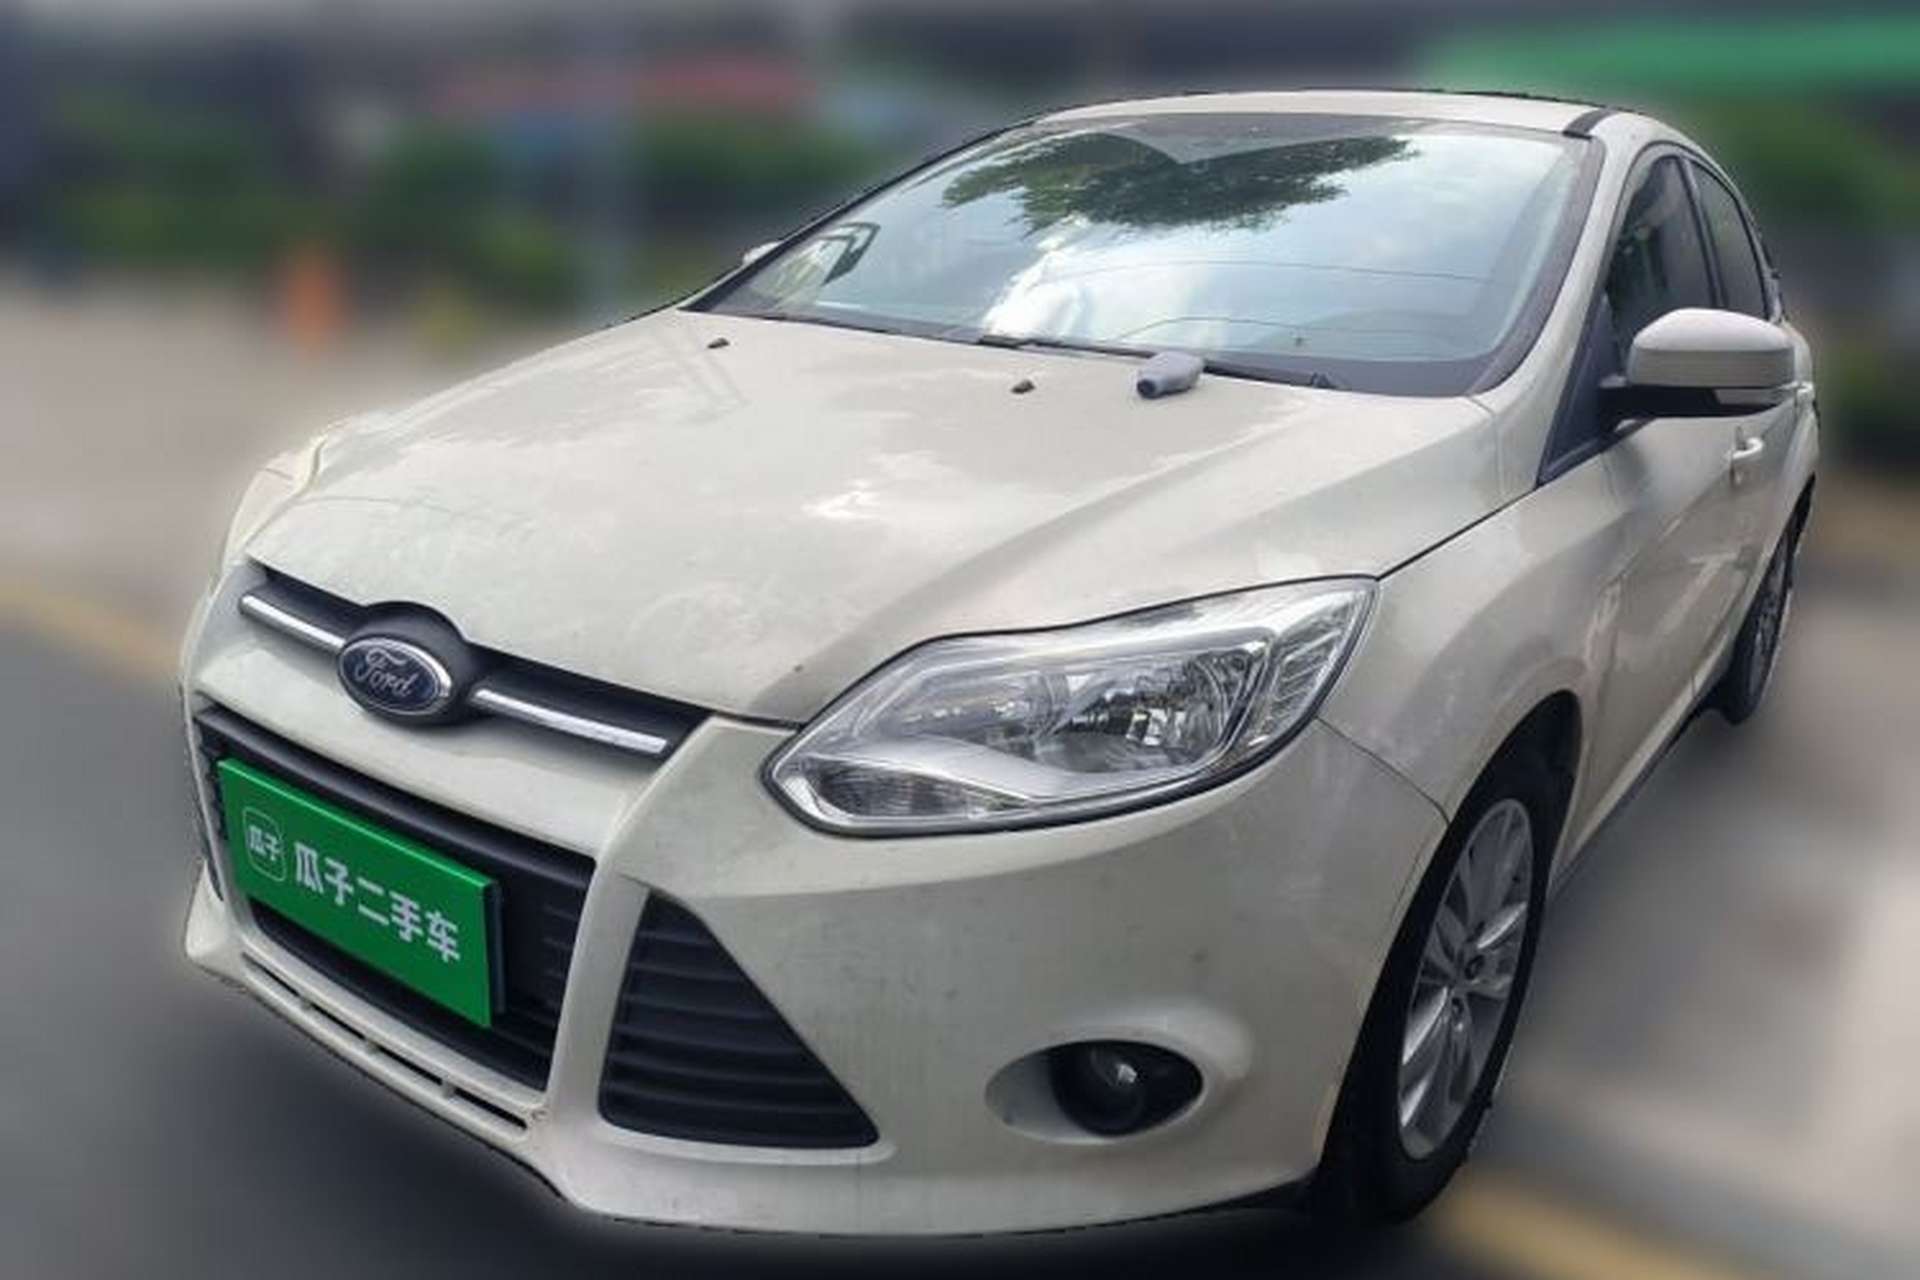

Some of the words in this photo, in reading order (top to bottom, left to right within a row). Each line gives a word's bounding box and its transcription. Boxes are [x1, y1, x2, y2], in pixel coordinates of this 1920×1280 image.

[354, 647, 417, 698] Ford
[248, 824, 282, 862] 瓜子
[294, 842, 460, 963] 瓜子二手车
